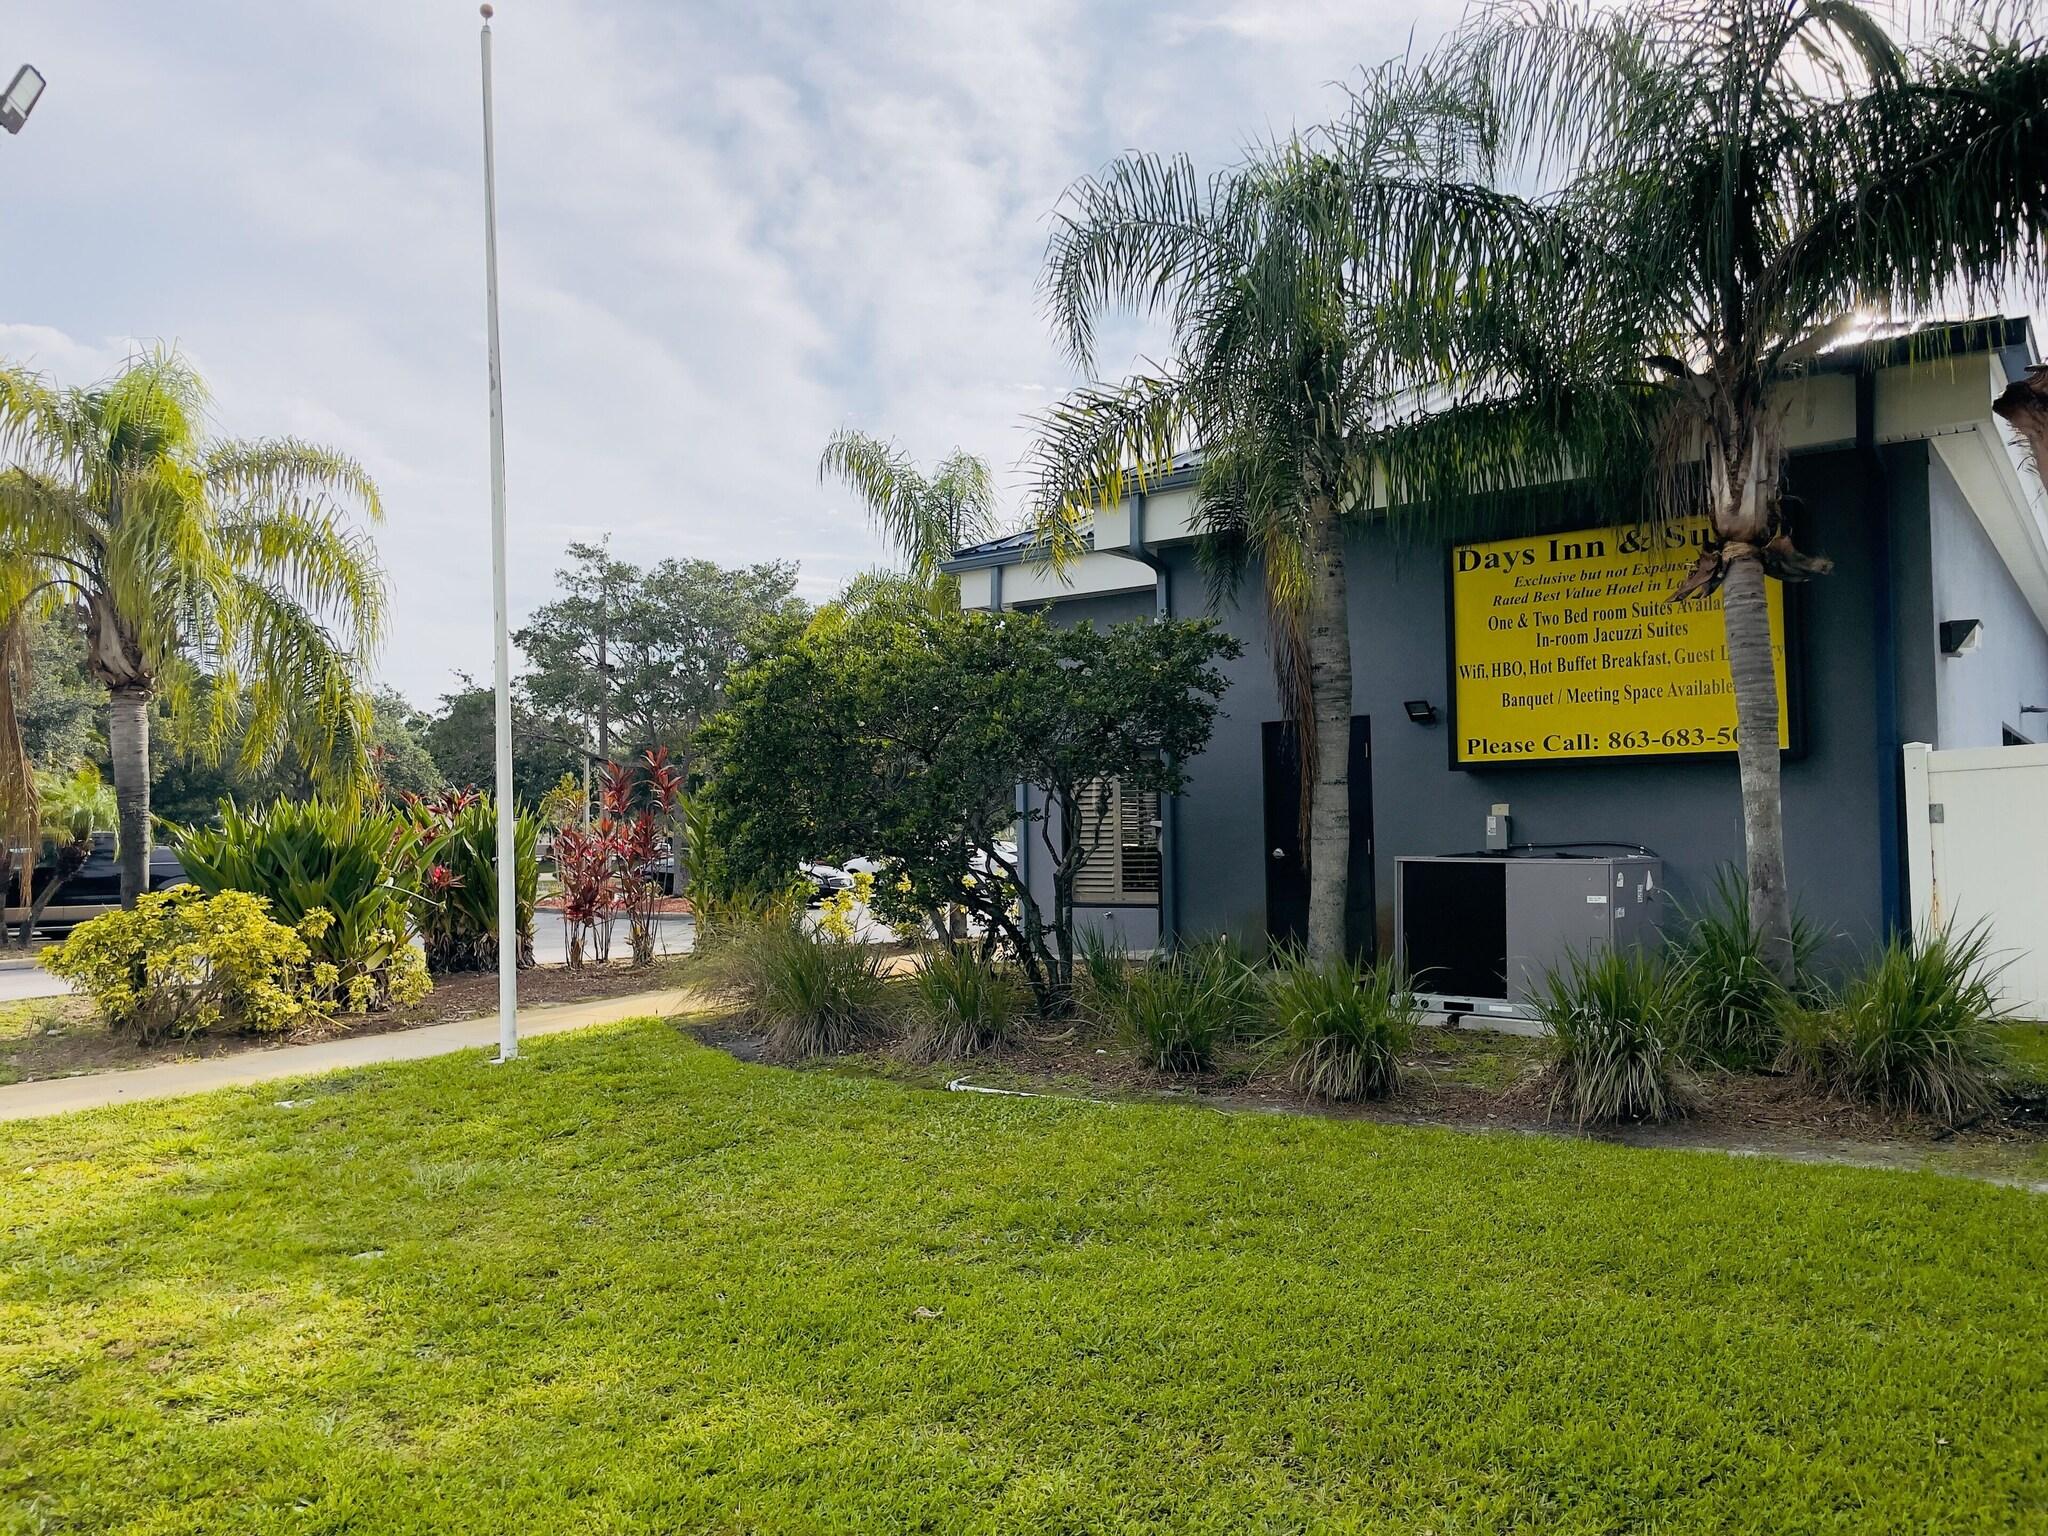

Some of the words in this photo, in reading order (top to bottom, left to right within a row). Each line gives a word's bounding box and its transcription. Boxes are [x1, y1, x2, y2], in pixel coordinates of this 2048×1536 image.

[1457, 549, 1536, 574] Days
[1547, 539, 1606, 563] Inn
[1619, 529, 1650, 554] &
[1514, 572, 1576, 588] Exclusive
[1580, 569, 1601, 581] but
[1606, 566, 1628, 579] not
[1632, 557, 1695, 576] Expensi
[1493, 592, 1529, 607] Rated
[1533, 591, 1561, 603] Best
[1566, 587, 1602, 600] Value
[1606, 580, 1644, 596] Hotel
[1648, 579, 1661, 592] in
[1488, 615, 1514, 631] One
[1517, 613, 1529, 628] &
[1533, 611, 1560, 627] Two
[1564, 607, 1588, 624] Bed
[1593, 607, 1627, 621] room
[1632, 601, 1673, 618] Suites
[1677, 596, 1724, 614] Availa
[1535, 632, 1589, 648] In-room
[1593, 623, 1643, 643] Jacuzzi
[1647, 621, 1689, 640] Suites
[1459, 664, 1489, 680] Wifi,
[1491, 660, 1527, 679] HBO,
[1529, 659, 1552, 675] Hot
[1557, 656, 1597, 673] Buffet
[1602, 650, 1671, 670] Breakfast,
[1674, 648, 1715, 665] Guest
[1502, 690, 1554, 710] Banquet
[1557, 688, 1562, 705] /
[1567, 686, 1619, 705] Meeting
[1624, 684, 1663, 704] Space
[1467, 738, 1535, 755] Please
[1543, 733, 1599, 752] Call:
